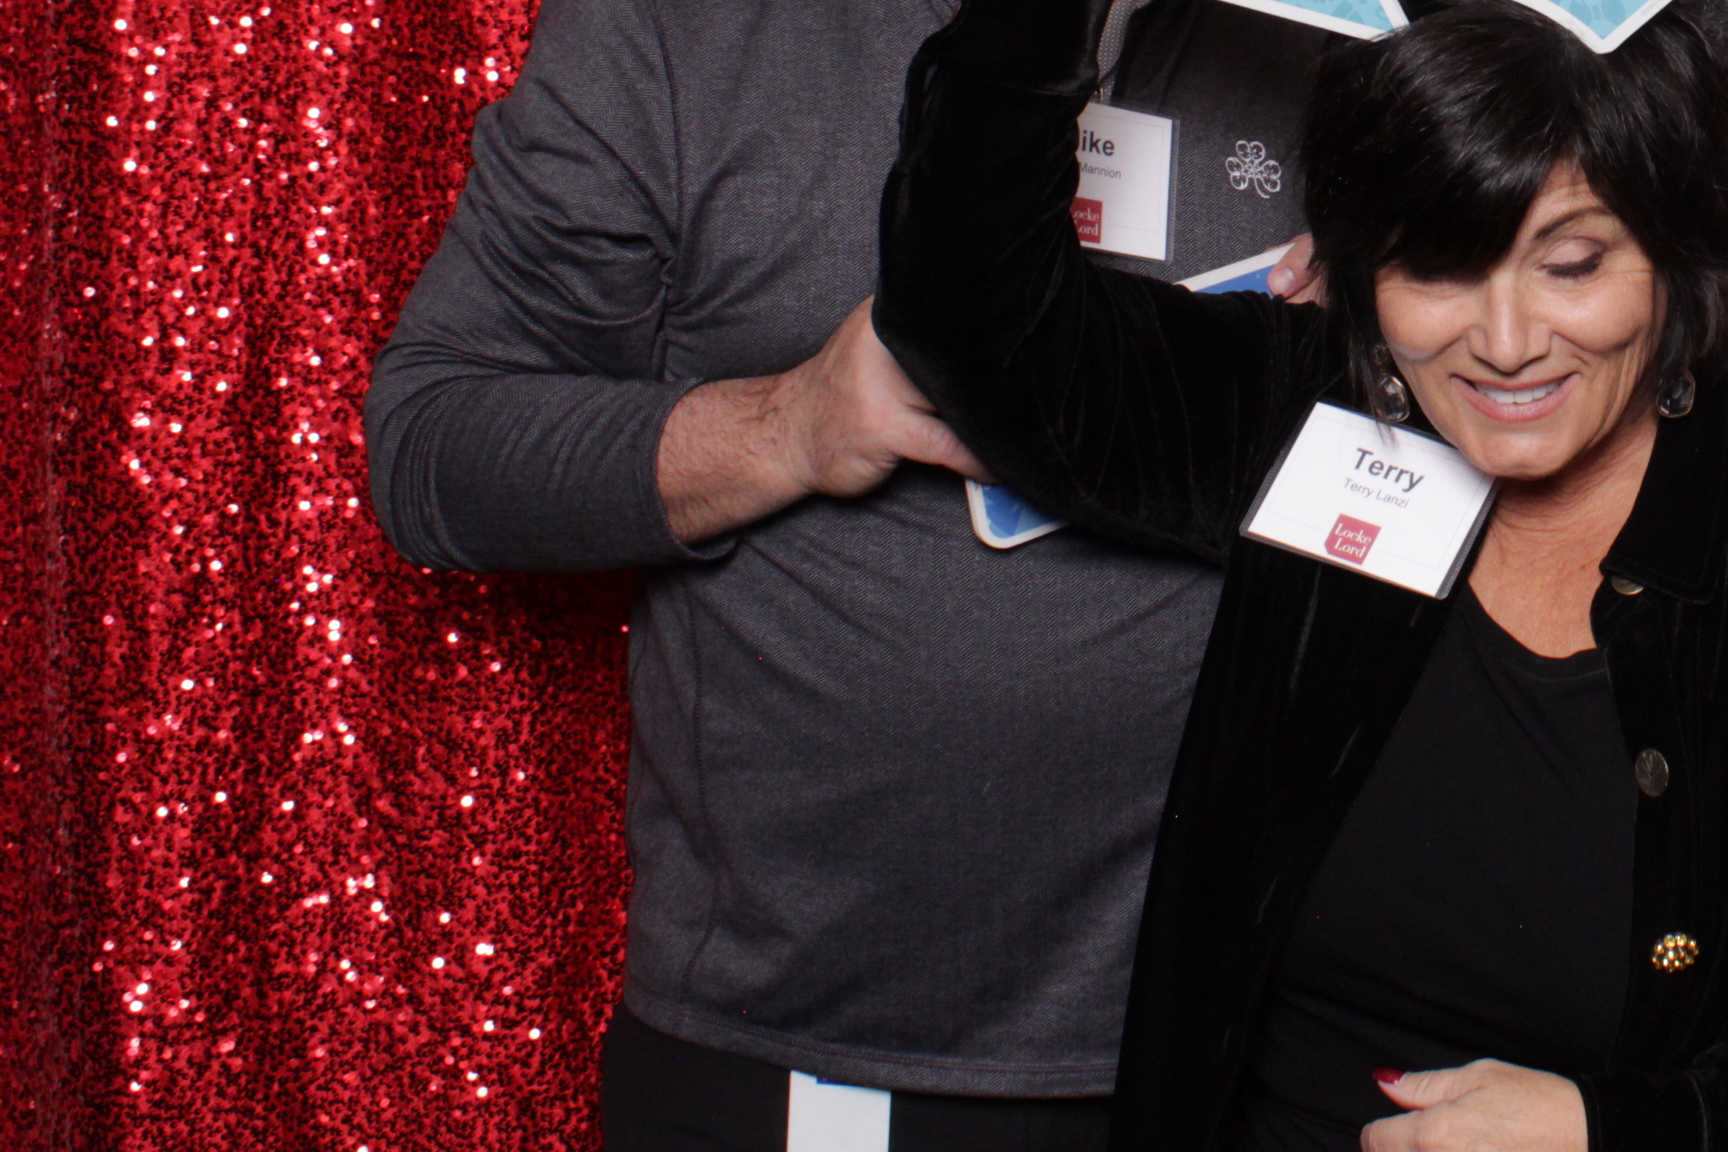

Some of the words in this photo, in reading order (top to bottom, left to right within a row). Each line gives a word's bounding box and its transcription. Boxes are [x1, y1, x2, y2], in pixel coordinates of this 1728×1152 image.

[1081, 130, 1115, 156] ike
[1073, 207, 1100, 222] ocke
[1355, 448, 1425, 493] Terry
[1343, 477, 1375, 499] Terry
[1376, 488, 1410, 509] Lanzi
[1334, 522, 1372, 546] Locke
[1333, 538, 1367, 558] Lord
